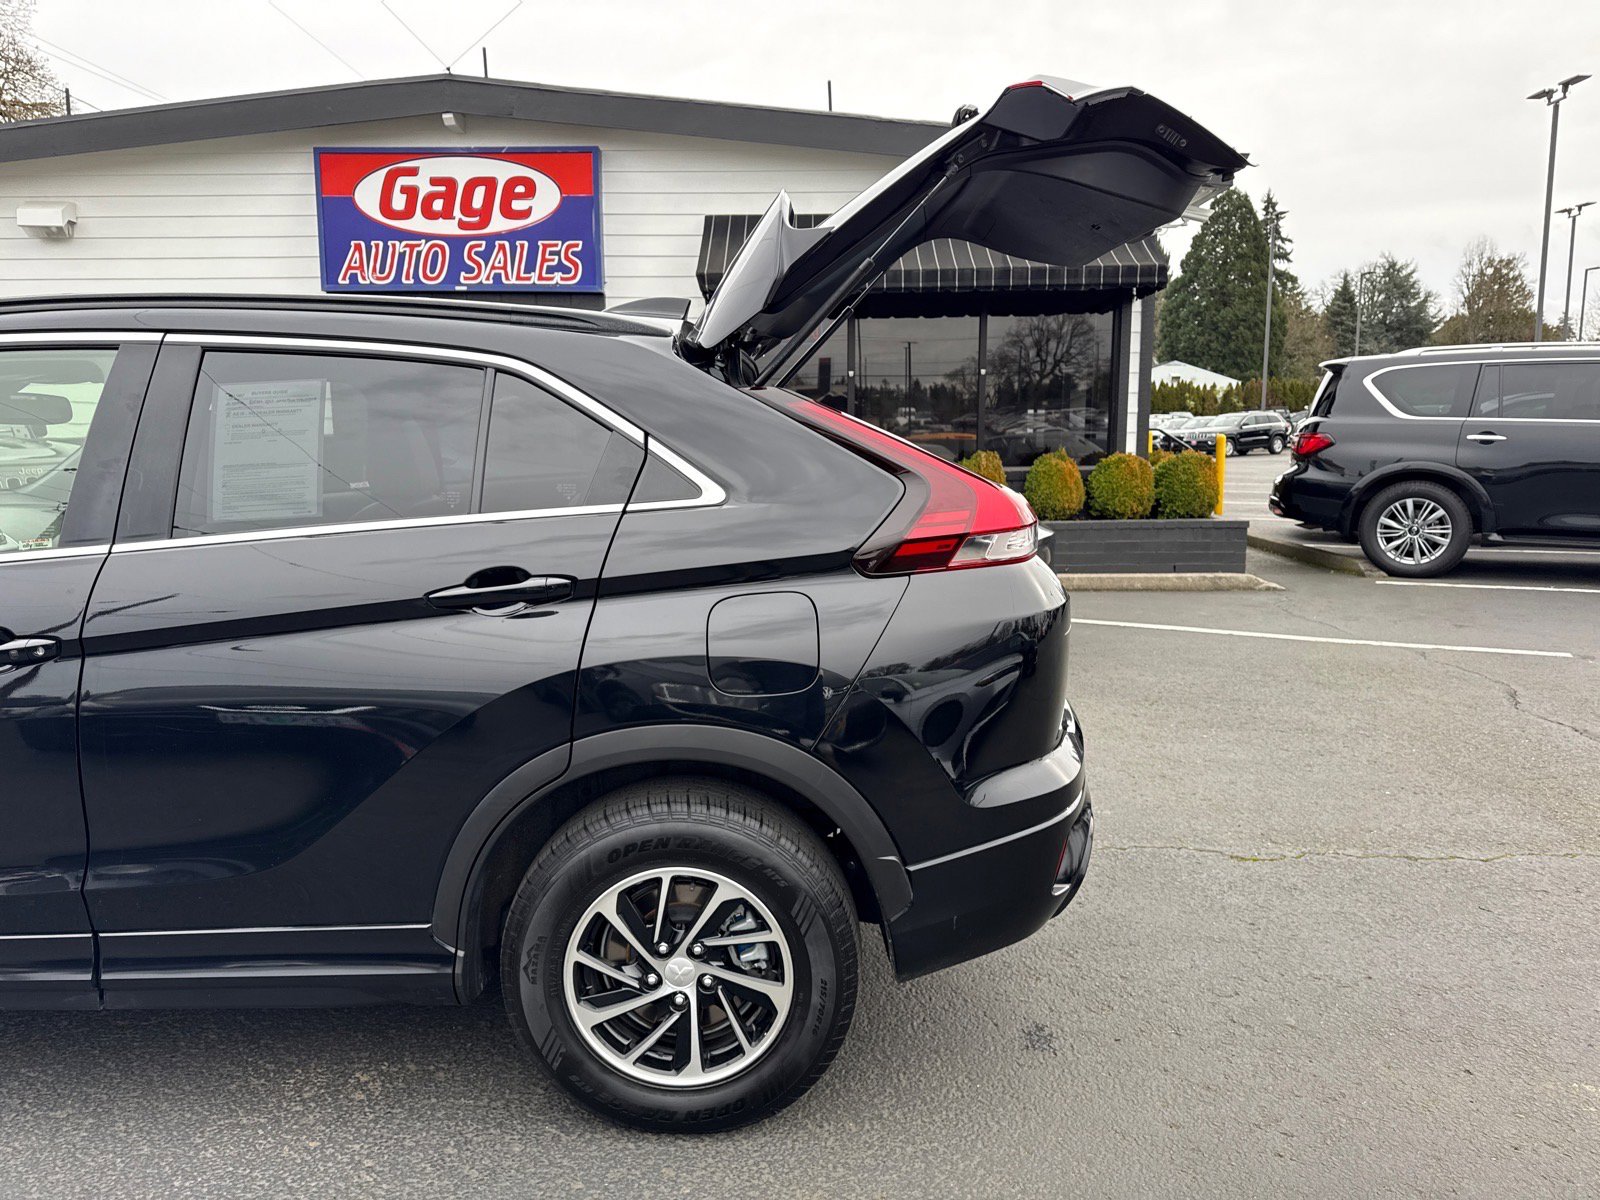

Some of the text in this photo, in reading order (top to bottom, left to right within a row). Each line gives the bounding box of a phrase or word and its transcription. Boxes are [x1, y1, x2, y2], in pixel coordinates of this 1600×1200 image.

[379, 165, 537, 231] Gage
[338, 240, 583, 284] AUTO SALES
[19, 466, 43, 477] Jeep
[607, 836, 672, 864] OPEN
